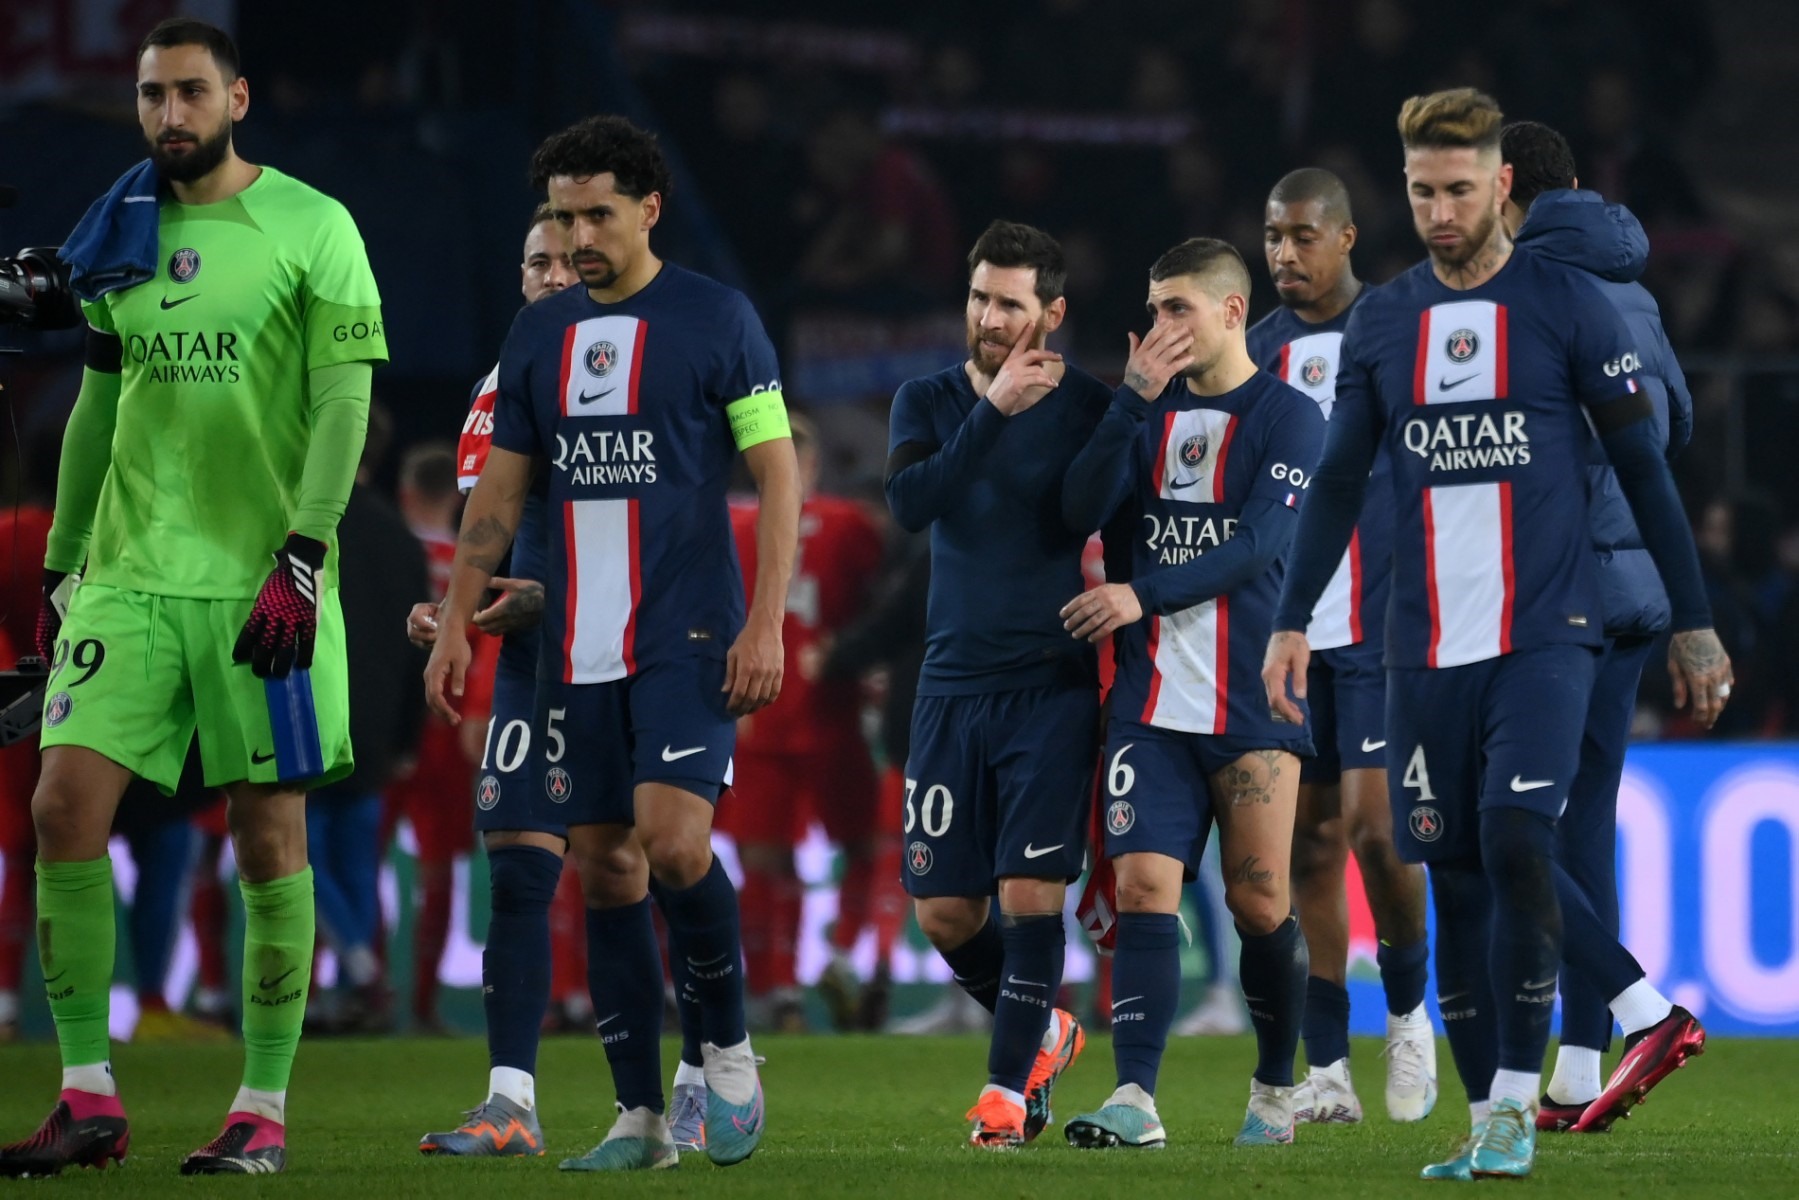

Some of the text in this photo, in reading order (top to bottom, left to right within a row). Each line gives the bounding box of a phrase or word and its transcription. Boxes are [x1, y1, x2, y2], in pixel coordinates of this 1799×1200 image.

[333, 320, 383, 342] GOA
[128, 331, 239, 367] QATAR
[149, 365, 240, 384] AIRWAYS
[1404, 411, 1529, 458] QATAR
[552, 430, 657, 472] QATAR
[1430, 442, 1531, 472] AIRWAYS
[571, 463, 657, 485] AIRWAYS
[47, 638, 105, 691] 99
[480, 714, 531, 773] 10
[545, 706, 566, 764] 5
[1108, 743, 1135, 797] 6
[1402, 744, 1437, 801] 4
[904, 778, 954, 838] 30
[49, 985, 75, 1000] RIS
[250, 988, 303, 1007] PARIS
[1001, 988, 1048, 1008] PARIS
[1112, 1012, 1145, 1024] ARIS
[1440, 1008, 1477, 1021] ARIS
[601, 1030, 630, 1044] RIS
